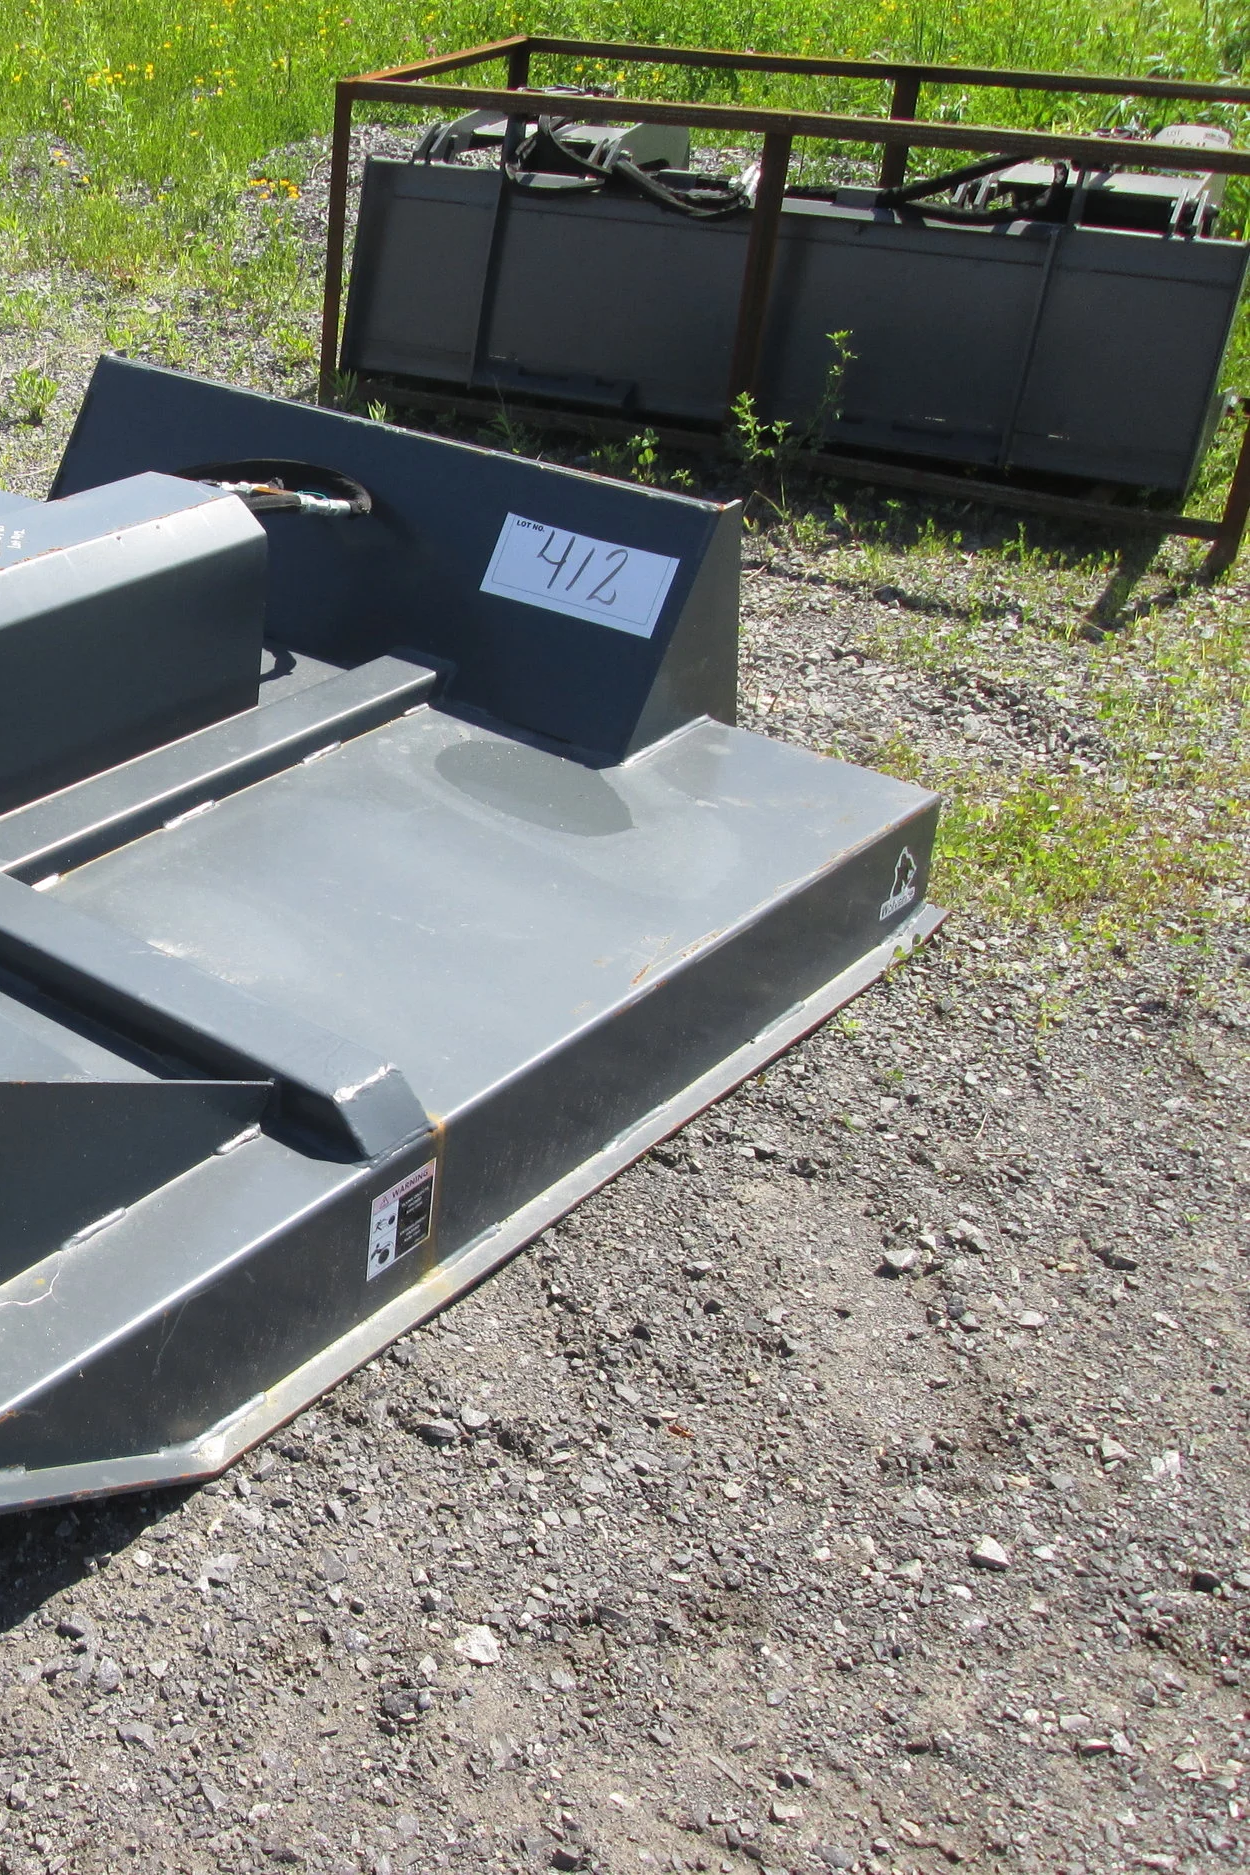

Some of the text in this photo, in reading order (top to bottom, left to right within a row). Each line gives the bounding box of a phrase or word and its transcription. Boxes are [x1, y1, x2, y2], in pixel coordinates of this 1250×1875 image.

[516, 519, 545, 532] LOT NO.
[536, 530, 628, 605] 412
[393, 1169, 429, 1198] WARNING
